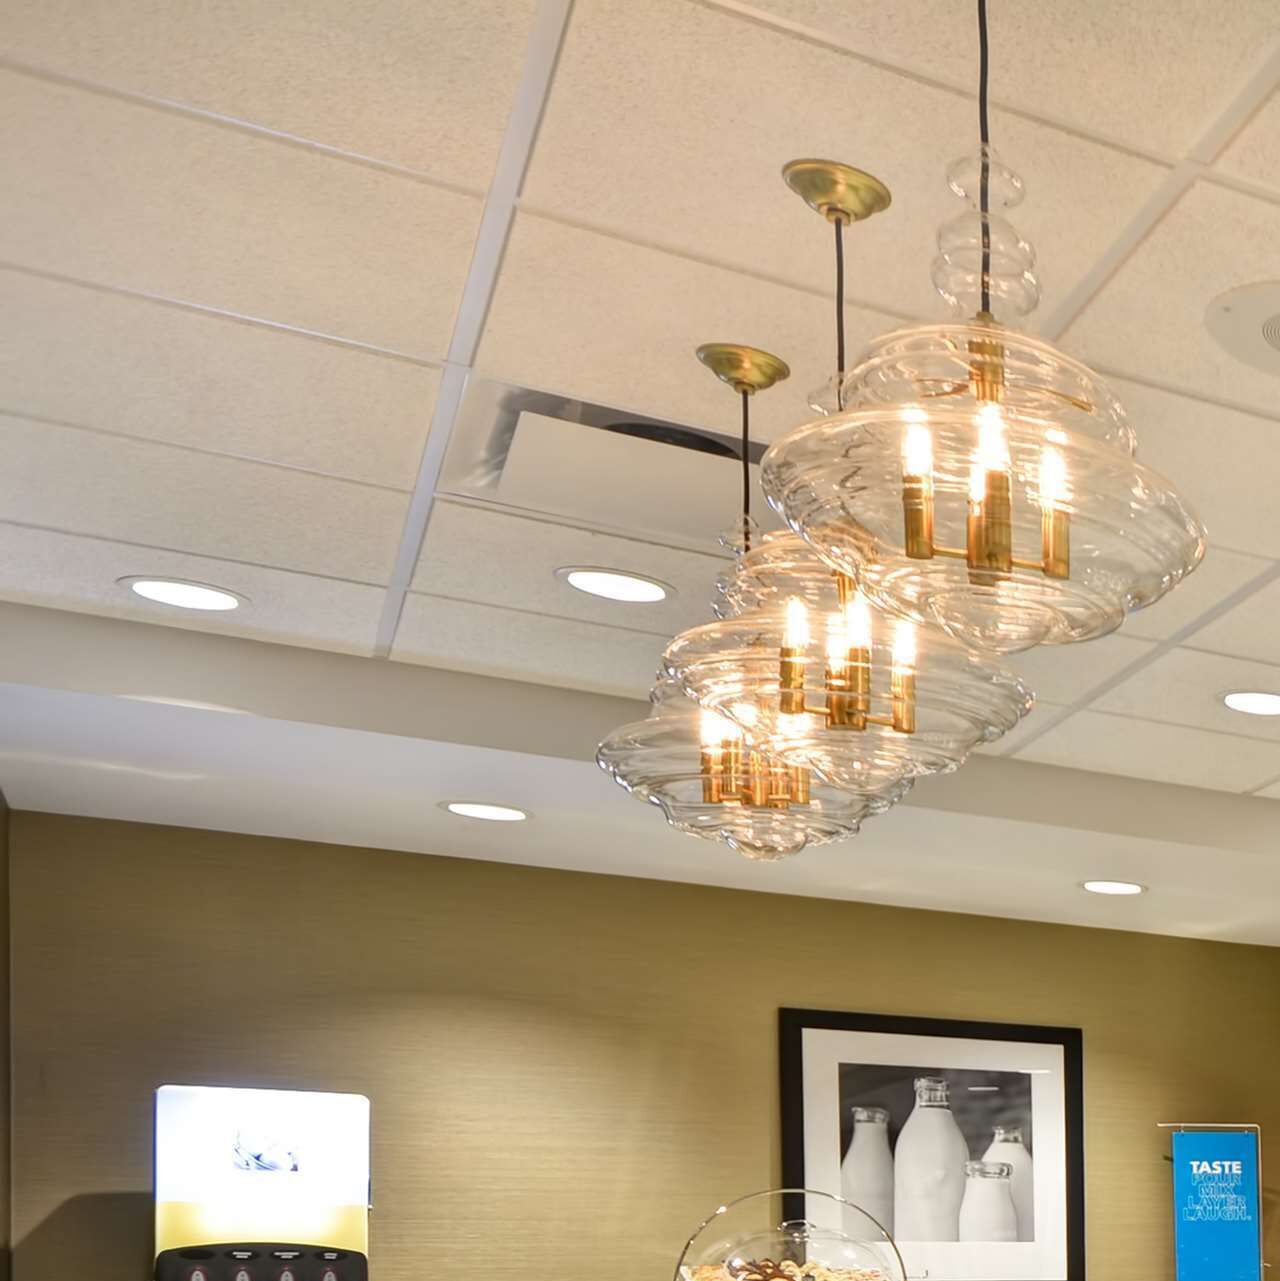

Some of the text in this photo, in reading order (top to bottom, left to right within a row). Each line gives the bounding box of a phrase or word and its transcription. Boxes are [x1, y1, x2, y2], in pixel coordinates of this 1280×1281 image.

[1189, 1161, 1242, 1174] TASTE
[1198, 1183, 1236, 1198] MIX
[1187, 1195, 1247, 1210] LAYER
